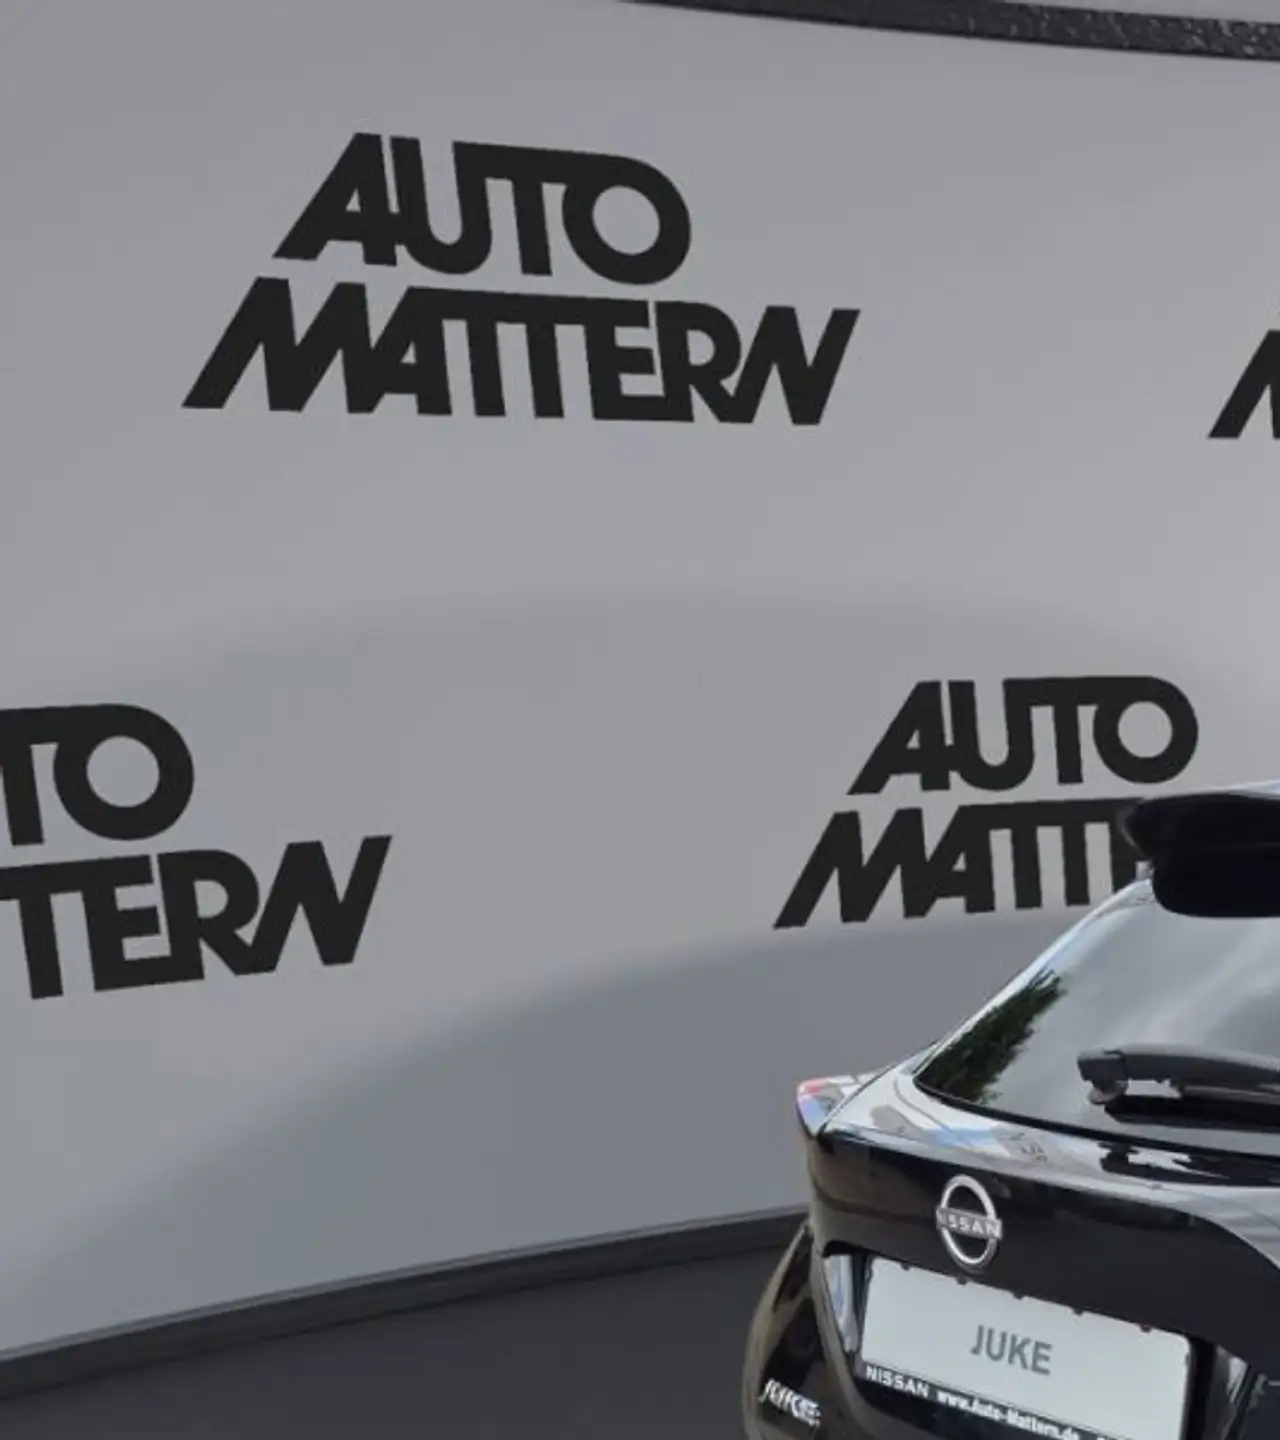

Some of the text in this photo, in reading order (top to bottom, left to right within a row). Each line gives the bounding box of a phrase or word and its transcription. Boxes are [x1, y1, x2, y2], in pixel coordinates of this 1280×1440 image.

[274, 133, 690, 284] AUTO
[183, 277, 859, 424] MATTERN
[0, 703, 194, 845] TO
[848, 677, 1198, 795] AUTO
[0, 835, 392, 999] TERN
[774, 797, 1141, 929] MATT
[937, 1208, 1002, 1239] NISSAN
[865, 1365, 929, 1399] NISSAN
[969, 1325, 1052, 1377] JUKE
